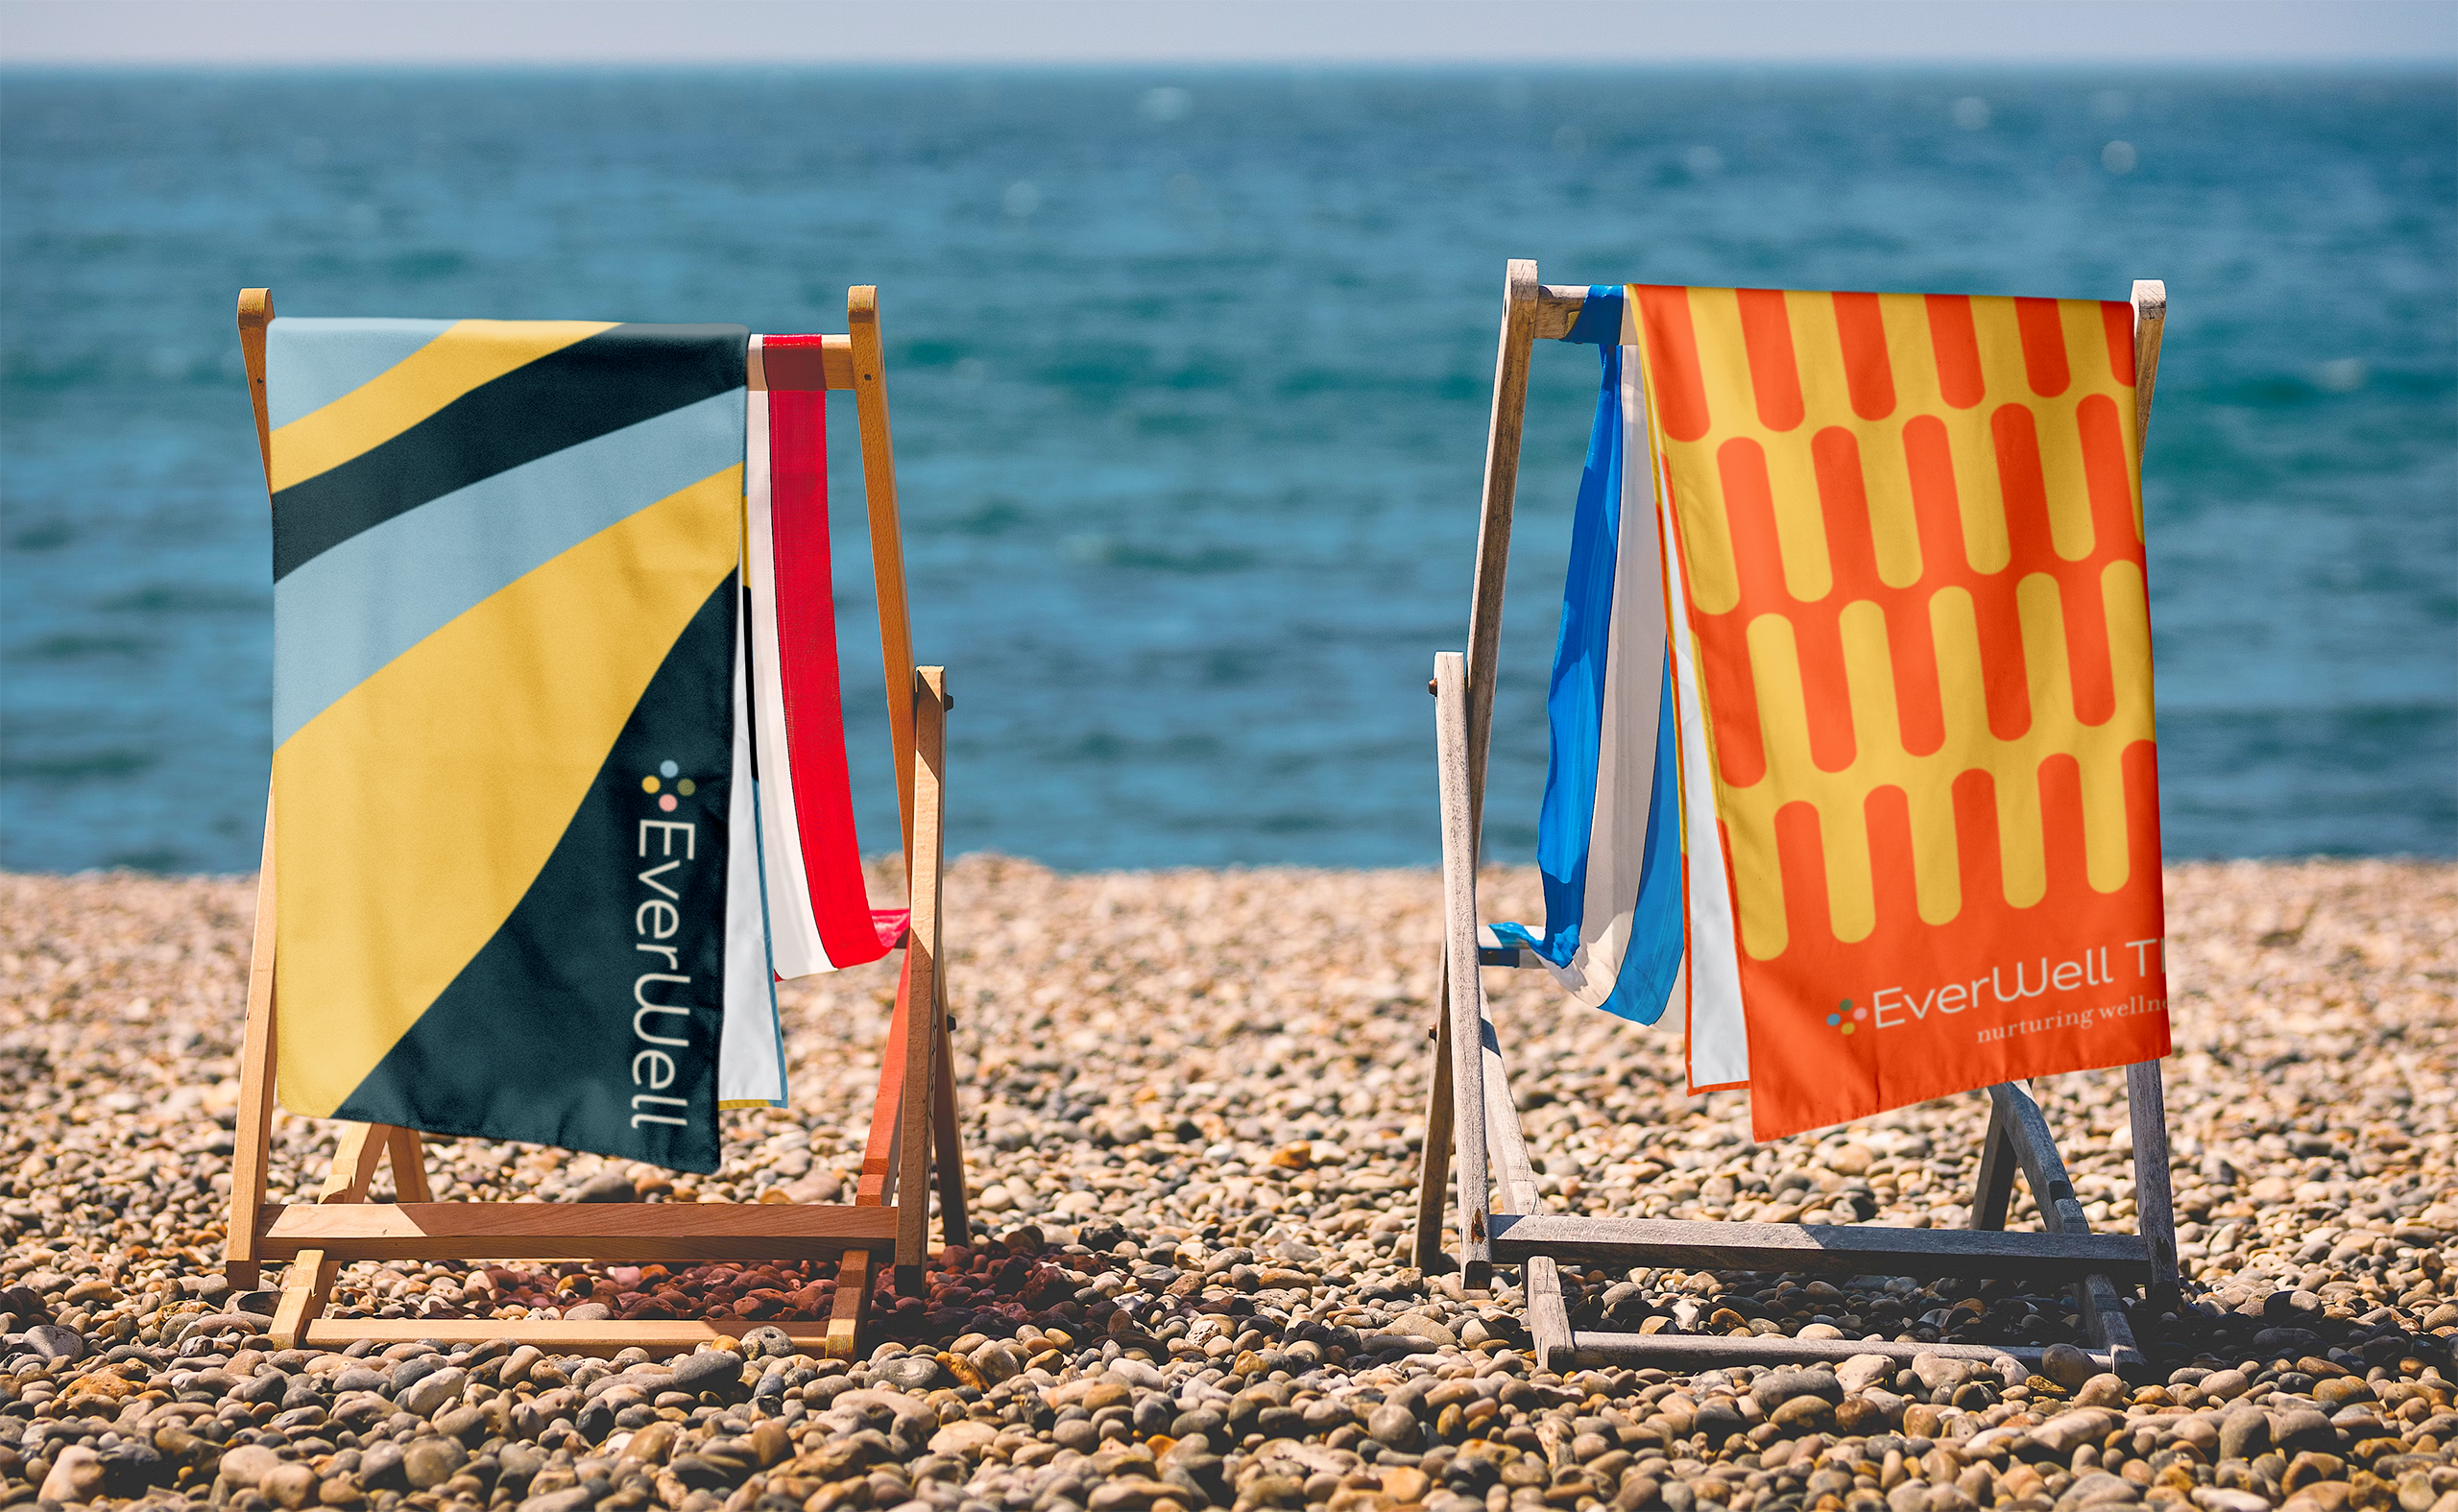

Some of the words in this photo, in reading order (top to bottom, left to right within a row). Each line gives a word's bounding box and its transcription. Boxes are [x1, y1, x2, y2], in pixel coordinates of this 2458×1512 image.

[631, 819, 695, 1129] EverWell
[1873, 947, 2113, 1029] EverWell
[2125, 937, 2166, 977] T
[1976, 1009, 2094, 1043] nurturing
